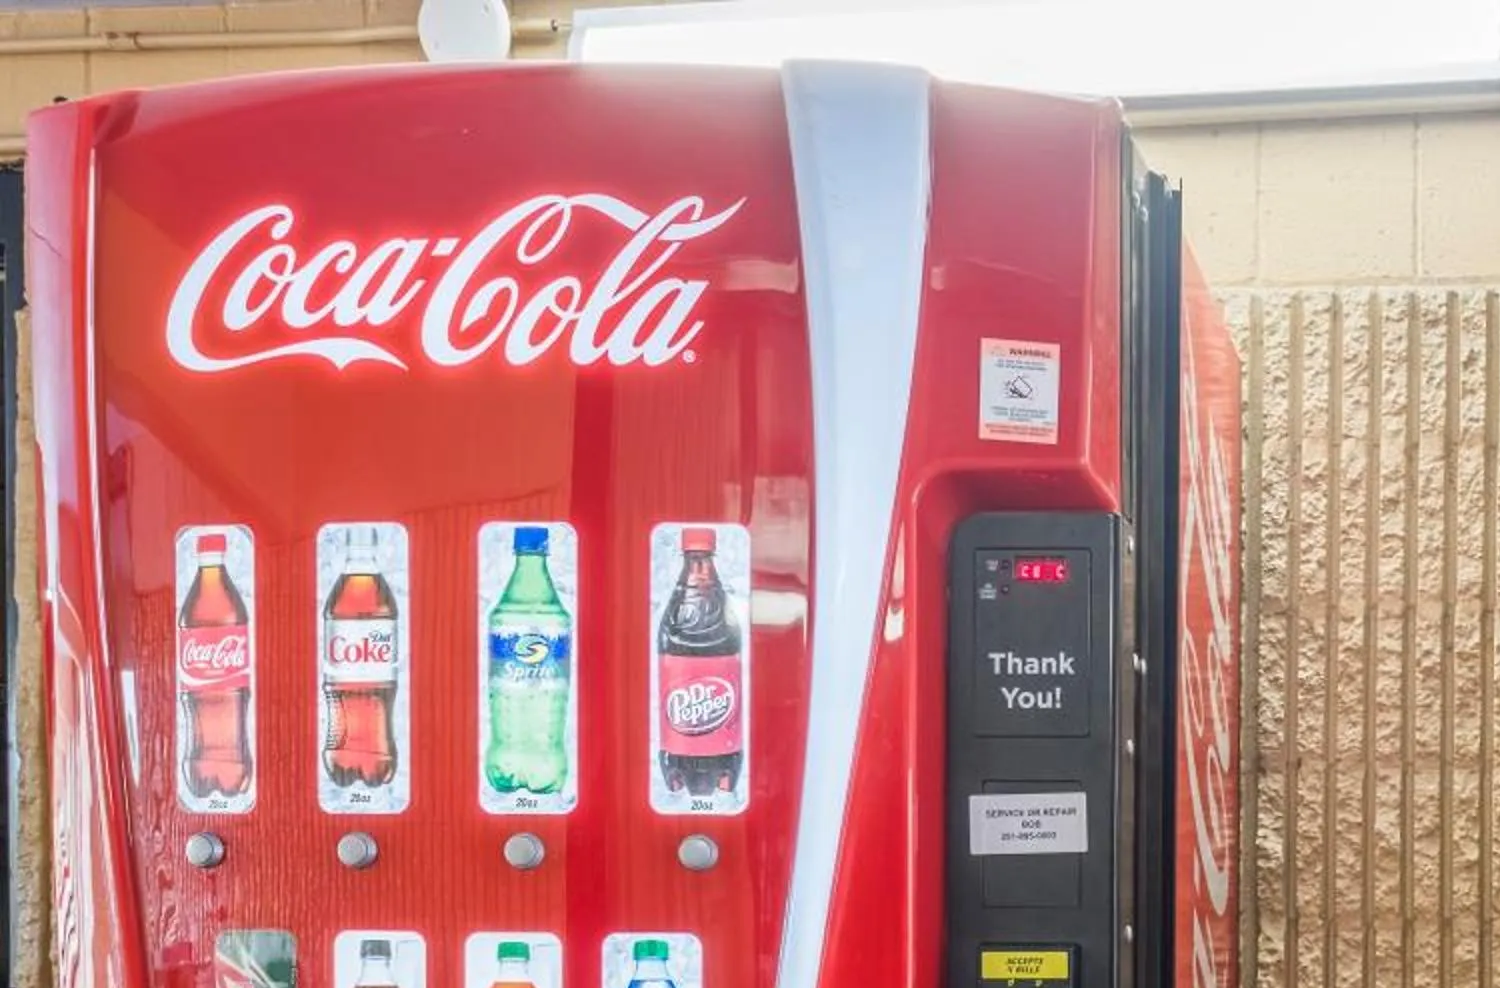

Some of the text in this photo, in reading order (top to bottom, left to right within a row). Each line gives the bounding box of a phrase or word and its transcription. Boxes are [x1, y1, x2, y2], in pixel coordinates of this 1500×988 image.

[165, 193, 747, 372] Coca-Cola
[182, 634, 247, 670] Coca-Cola
[328, 636, 392, 665] Coke
[987, 651, 1076, 676] Thank
[502, 661, 557, 685] Sprite
[668, 686, 732, 726] Pepper
[688, 682, 717, 705] Dr
[1000, 686, 1062, 710] You!
